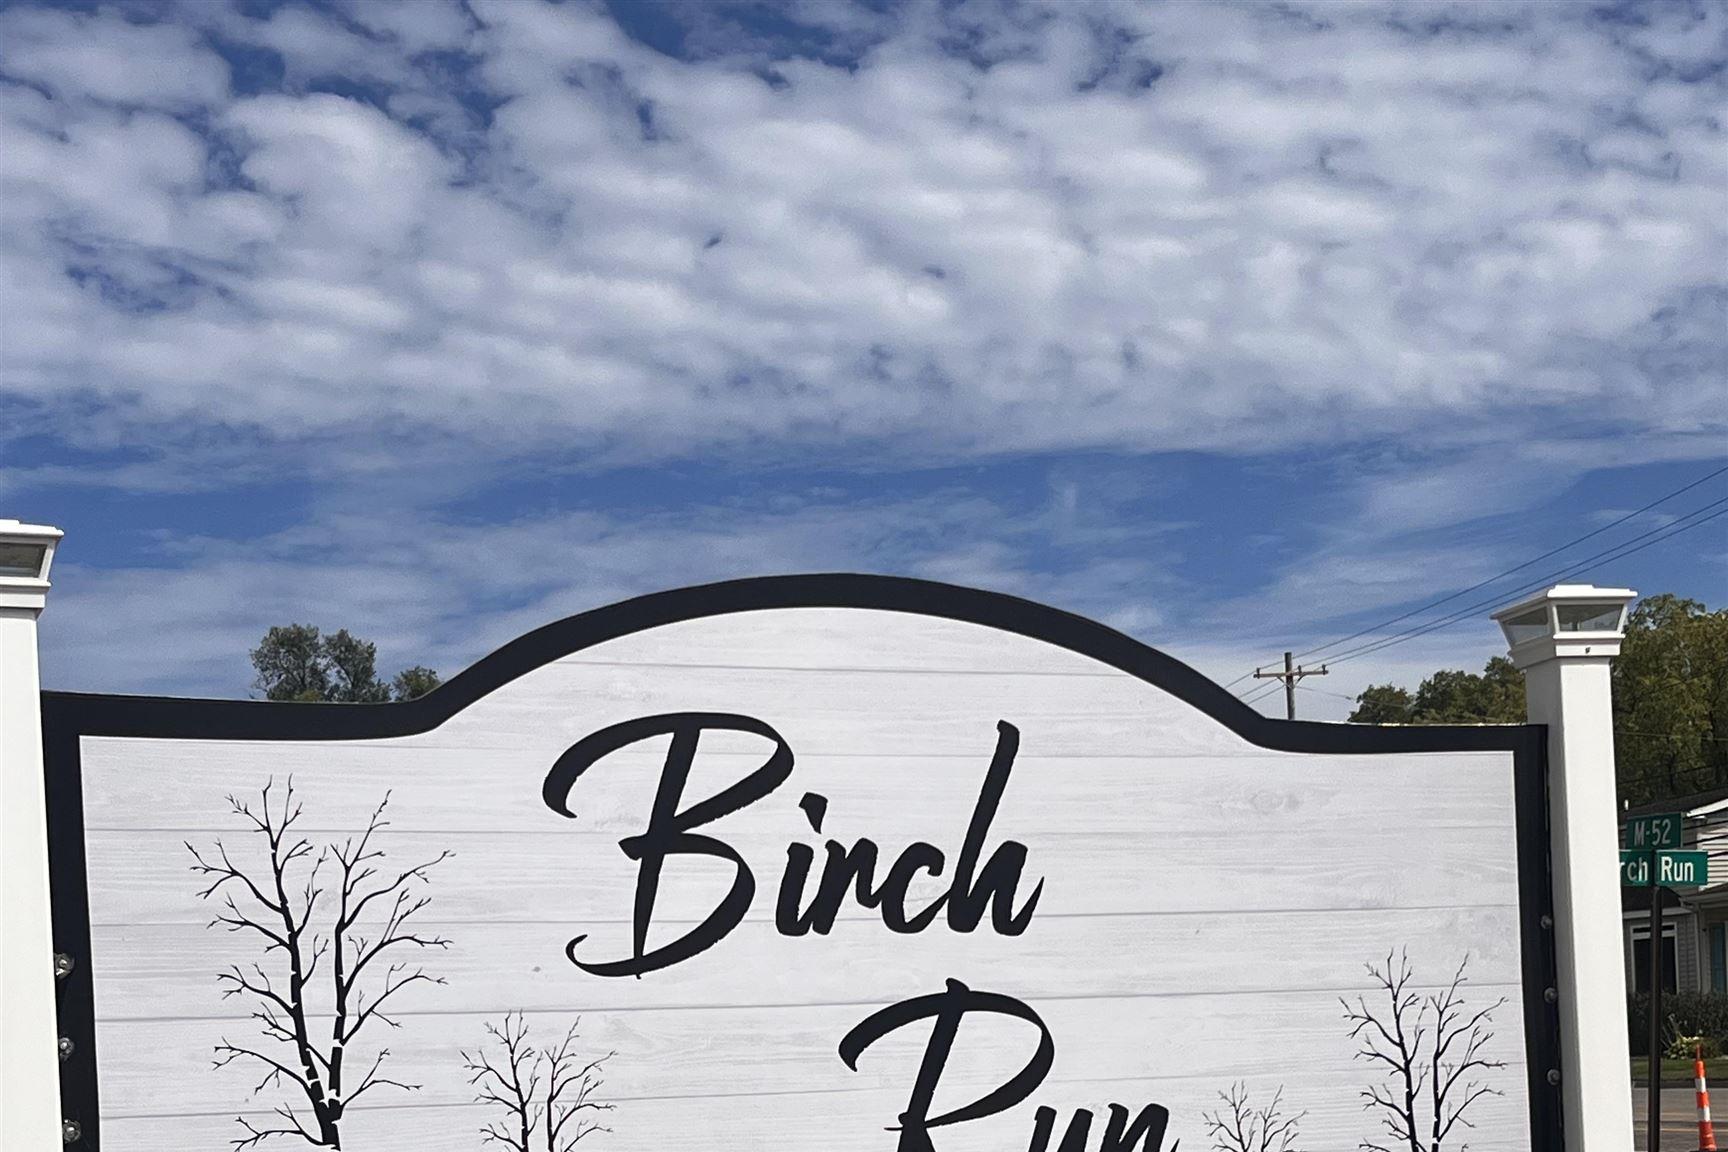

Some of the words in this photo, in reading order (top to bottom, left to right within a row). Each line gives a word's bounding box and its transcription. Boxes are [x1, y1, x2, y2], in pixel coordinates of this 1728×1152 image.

[543, 711, 1044, 980] Birch
[1634, 819, 1672, 846] M-52
[1661, 856, 1694, 882] Run
